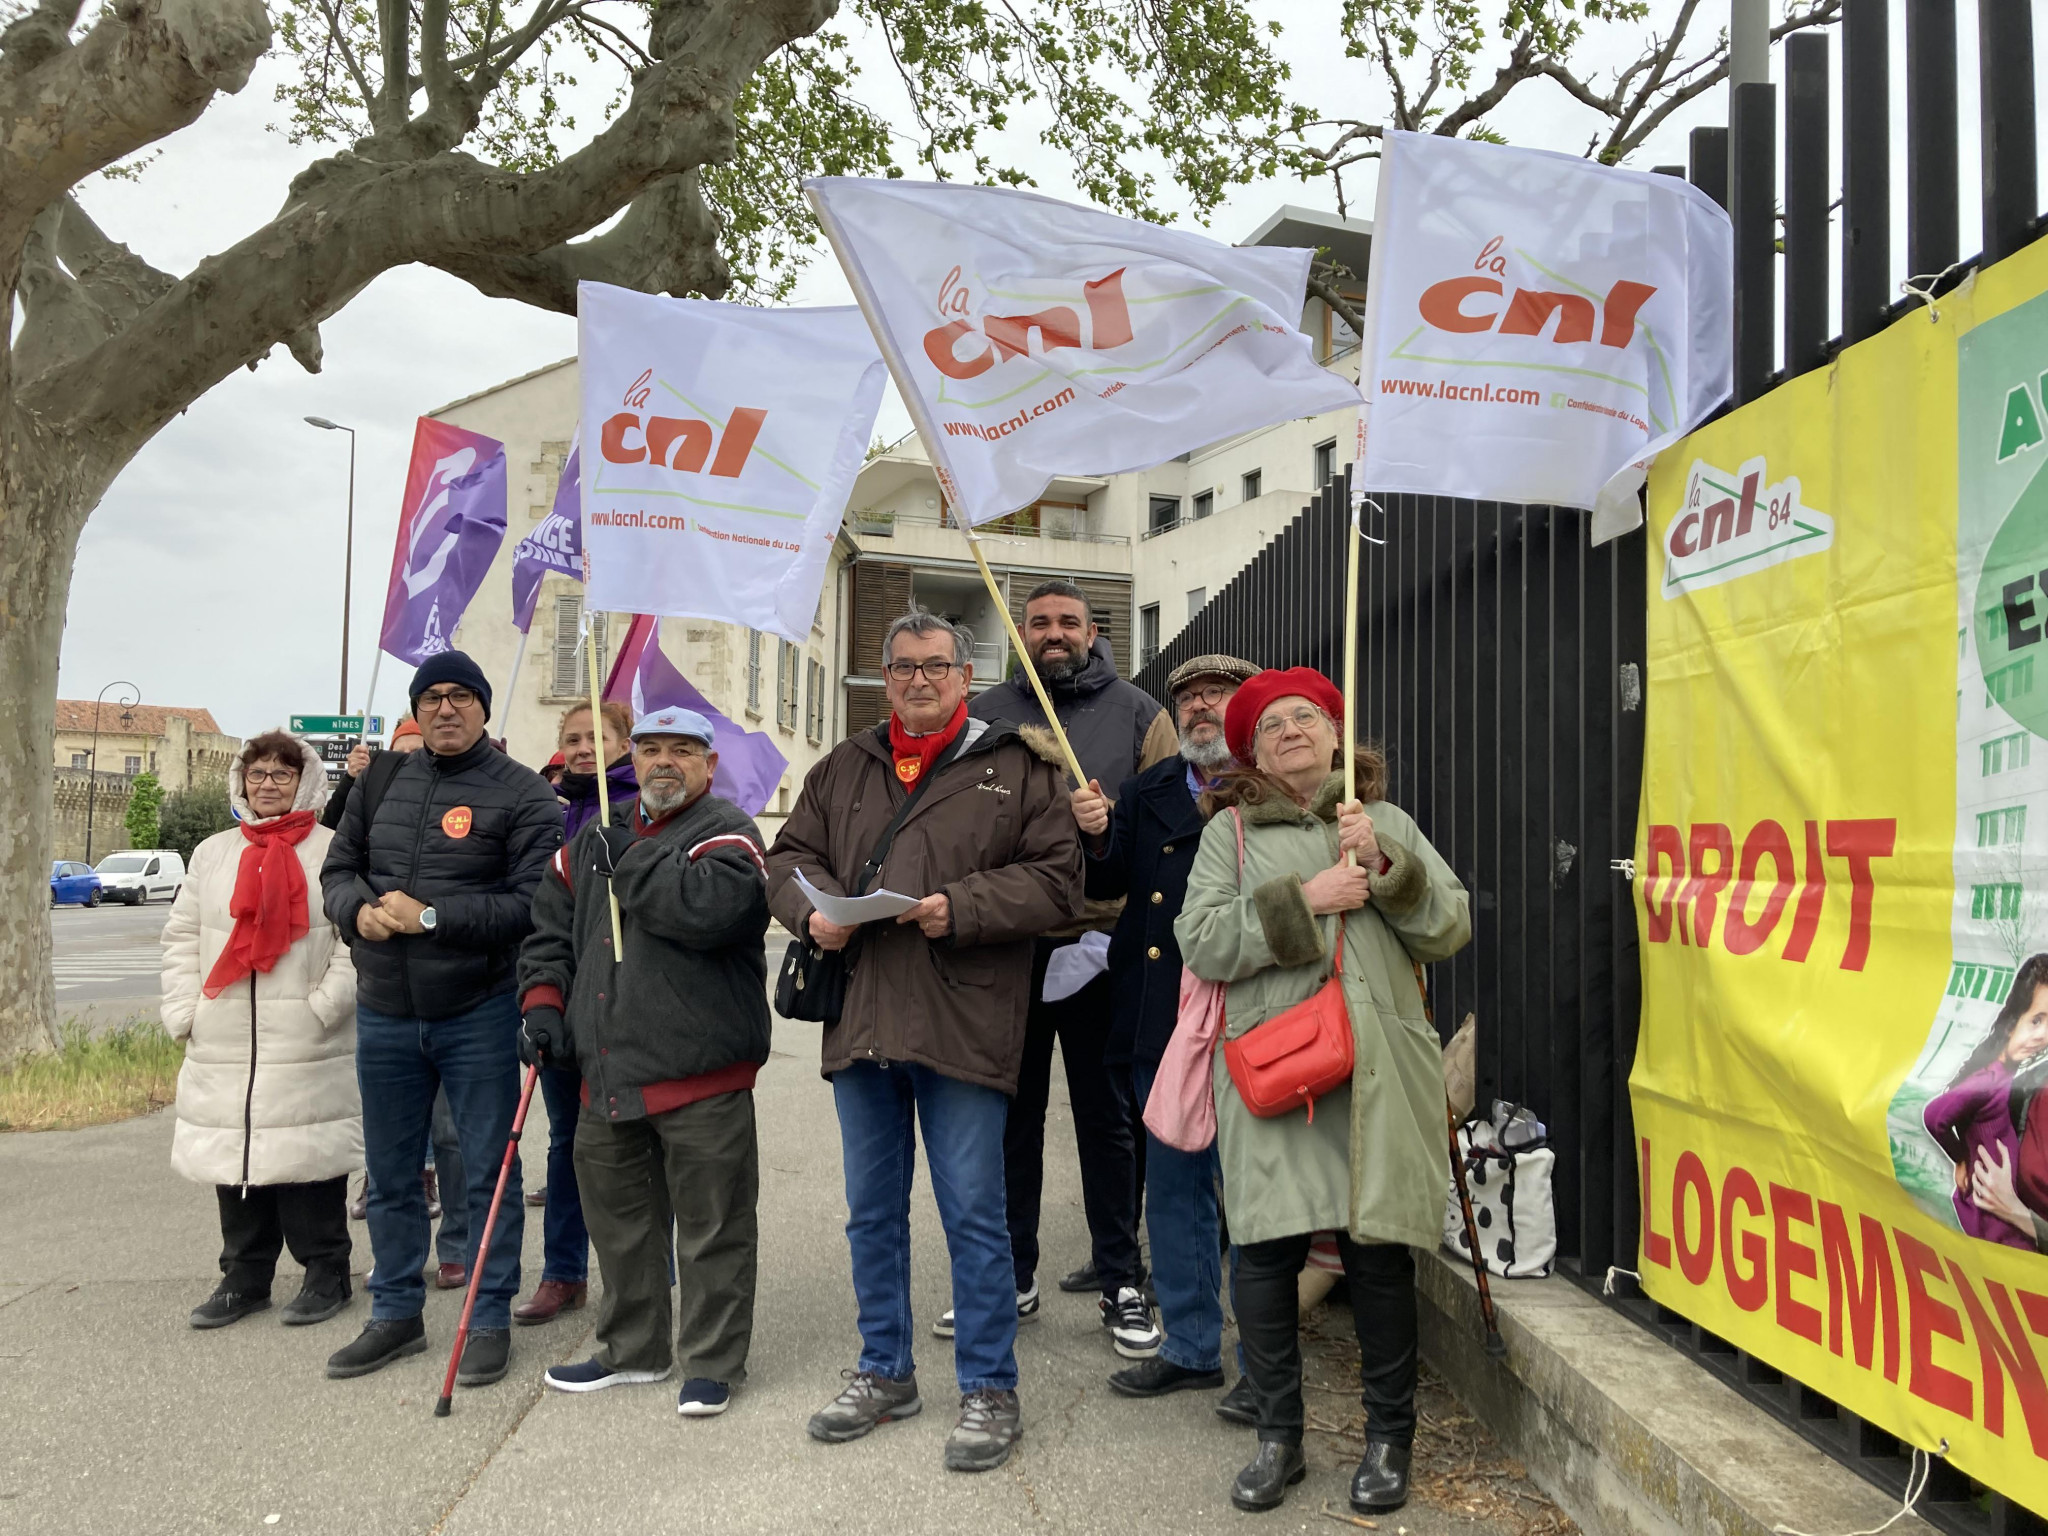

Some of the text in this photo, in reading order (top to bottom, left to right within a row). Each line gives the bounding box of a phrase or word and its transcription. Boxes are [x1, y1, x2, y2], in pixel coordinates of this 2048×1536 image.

[1474, 235, 1507, 277] la
[938, 265, 970, 316] la
[923, 267, 1134, 380] cnl
[1418, 276, 1658, 350] cnl
[624, 368, 652, 409] la
[1381, 379, 1540, 406] www.lacnl.com
[943, 387, 1076, 441] www.lacnl.com
[1617, 410, 1629, 420] du
[601, 406, 768, 478] cnl
[1688, 472, 1701, 509] la
[1670, 471, 1791, 557] cnl 84
[732, 533, 771, 547] Nationale
[773, 539, 783, 549] du
[332, 720, 360, 729] NÎMES
[328, 743, 343, 751] Des
[1644, 818, 1897, 972] DROIT
